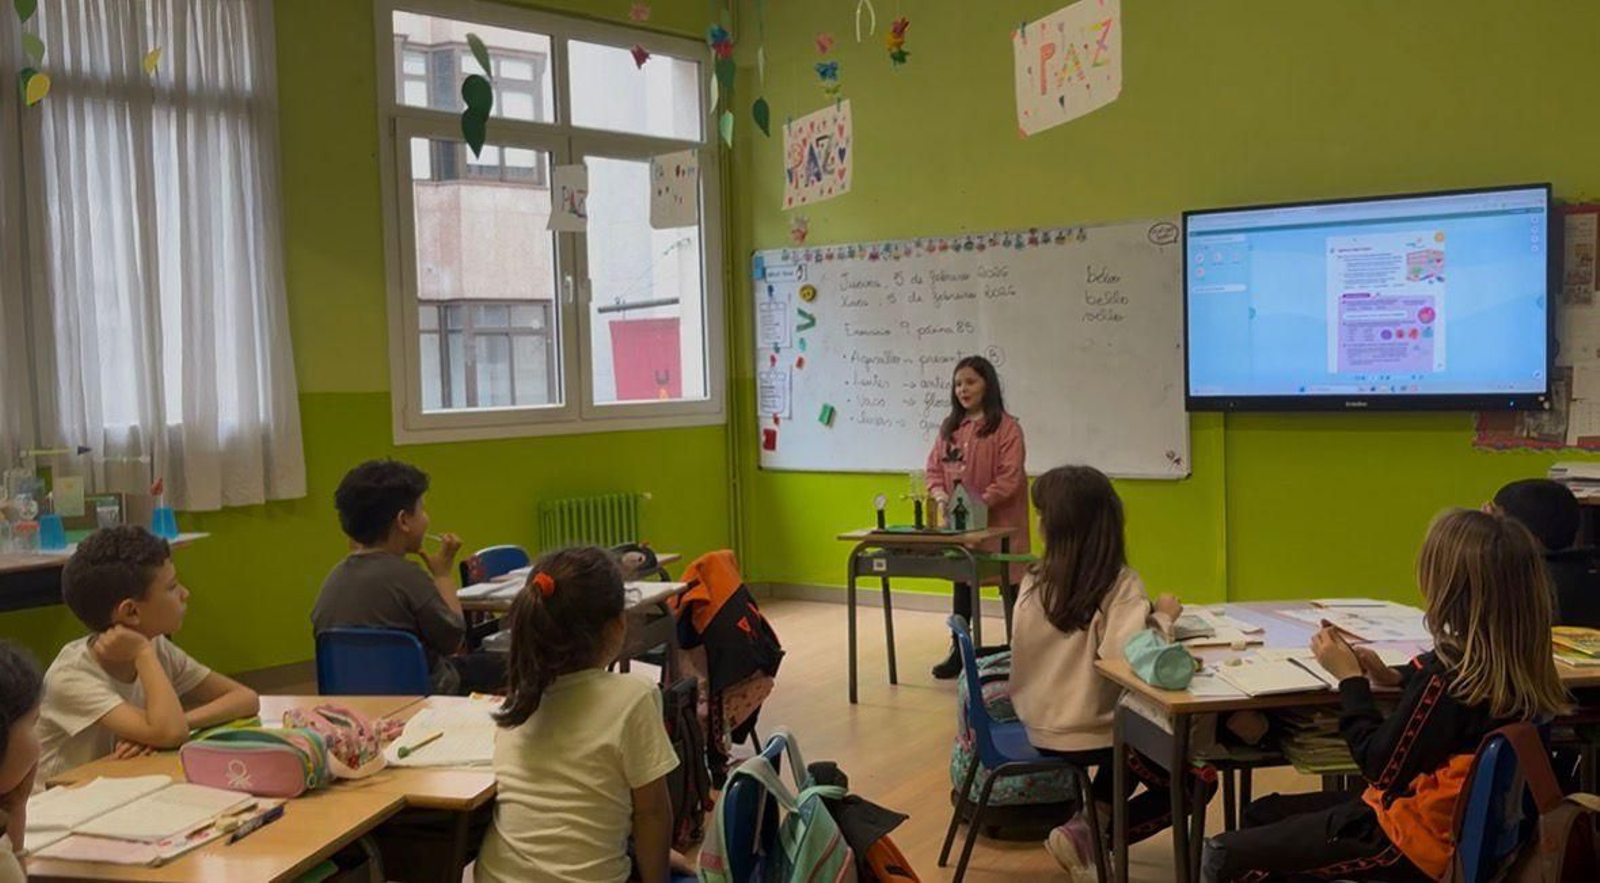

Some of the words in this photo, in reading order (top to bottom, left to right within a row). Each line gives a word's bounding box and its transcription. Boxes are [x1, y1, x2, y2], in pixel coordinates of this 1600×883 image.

[1040, 18, 1113, 95] PAZ
[791, 135, 835, 190] PAZ
[893, 271, 905, 287] 5
[911, 273, 923, 285] de
[908, 291, 923, 304] de
[956, 320, 976, 335] 85
